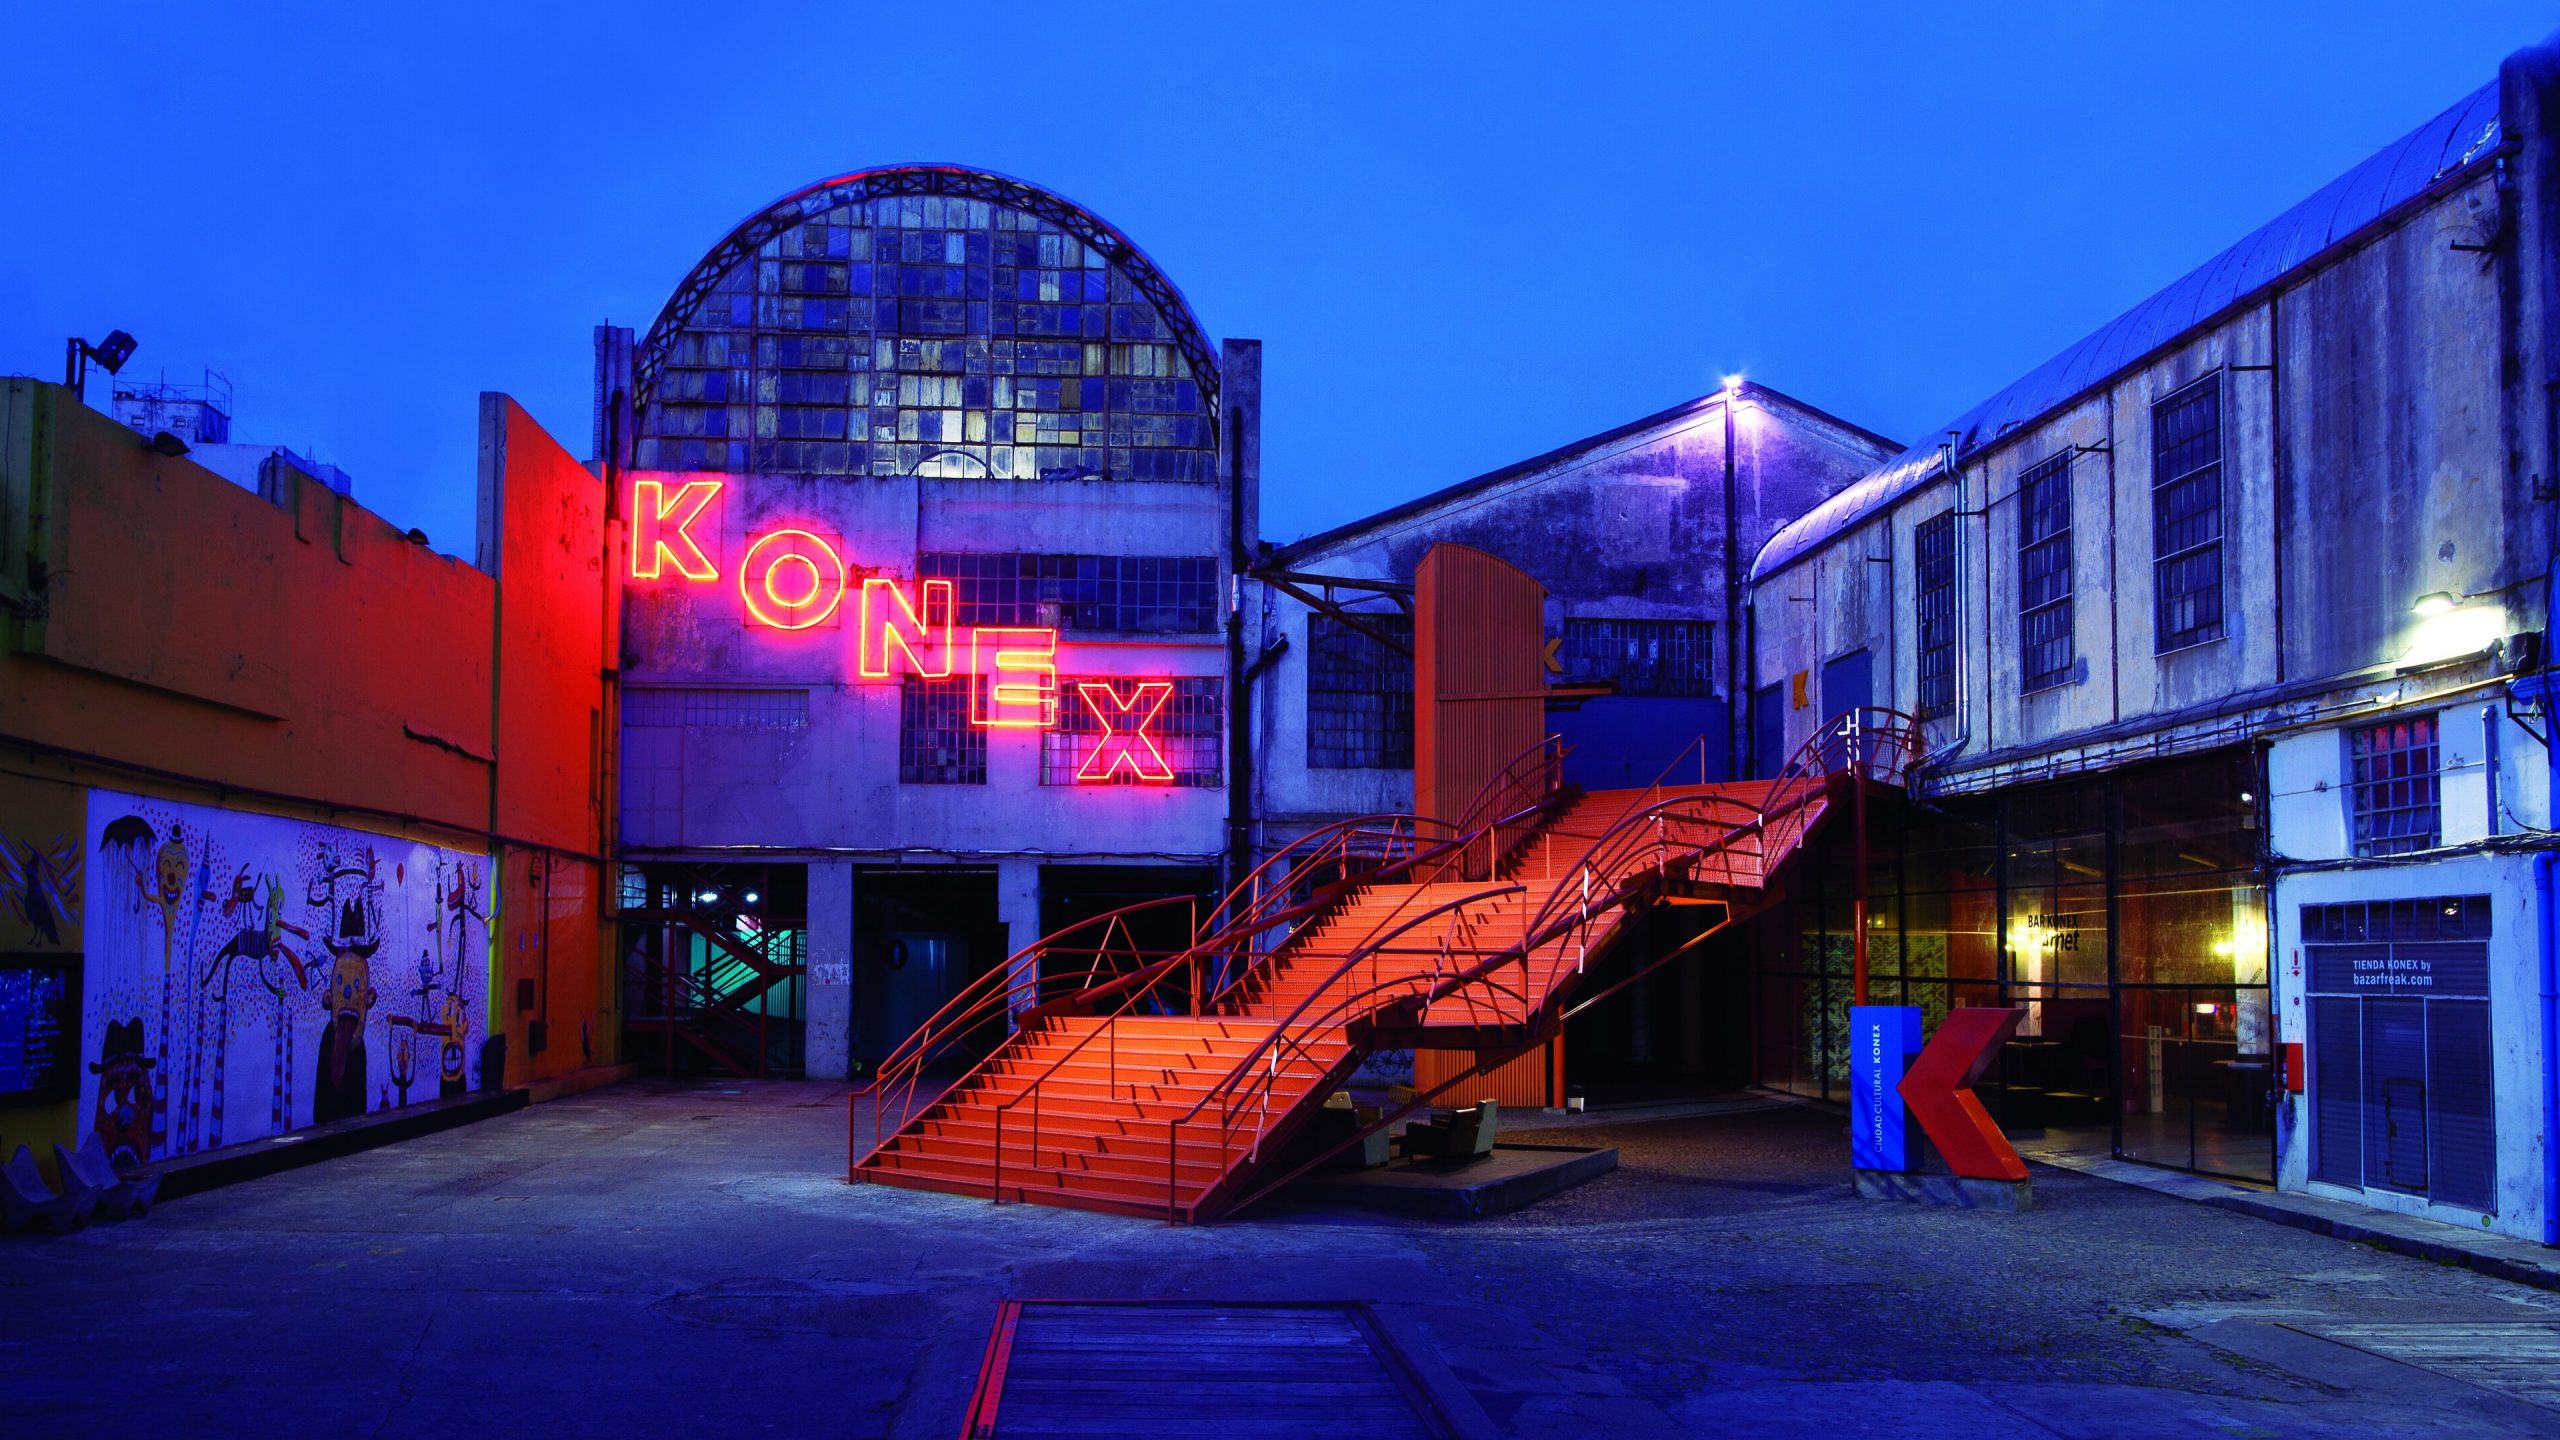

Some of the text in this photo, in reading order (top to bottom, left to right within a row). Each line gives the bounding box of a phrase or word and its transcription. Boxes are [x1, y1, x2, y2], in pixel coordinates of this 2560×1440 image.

[631, 479, 1175, 781] KONEX
[1792, 669, 1809, 711] K
[2028, 914, 2078, 929] BAR KONEX
[2353, 960, 2431, 972] TIENDA KONEX by
[2353, 973, 2432, 986] bazarfreak.com
[1872, 1024, 1883, 1153] CIUDAD CULTURAL KONEX
